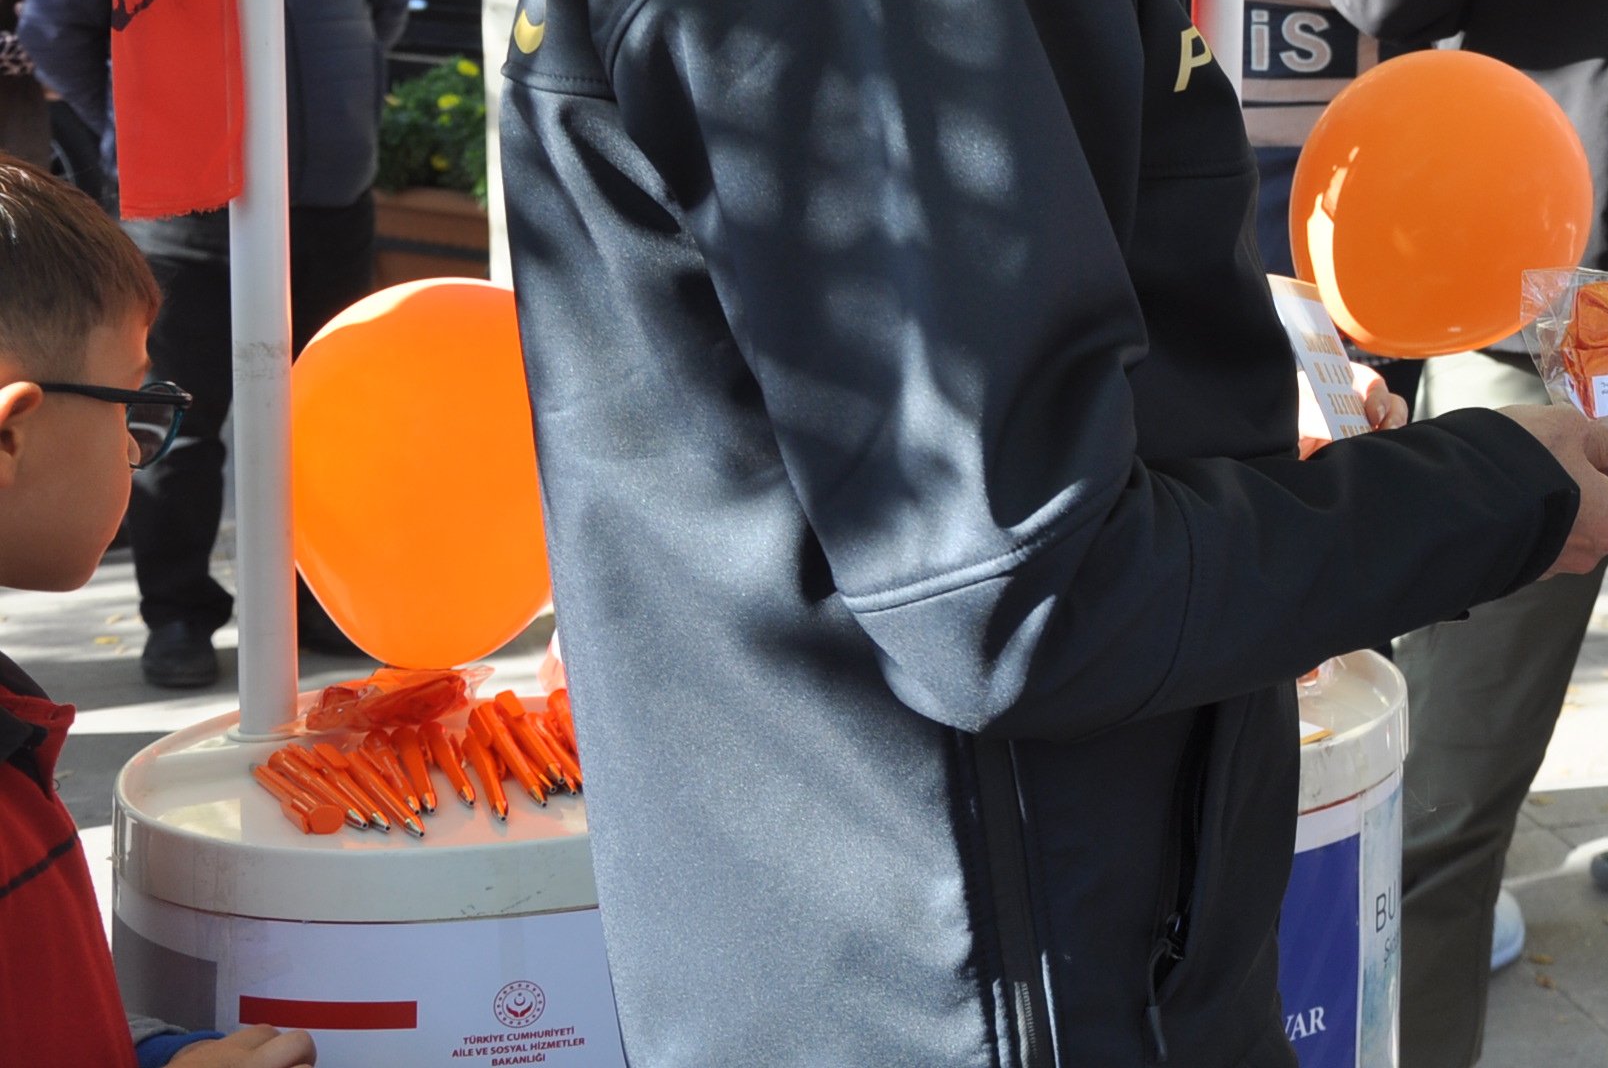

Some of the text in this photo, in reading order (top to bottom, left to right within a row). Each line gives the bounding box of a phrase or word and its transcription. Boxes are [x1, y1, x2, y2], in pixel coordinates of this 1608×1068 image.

[463, 1026, 575, 1045] TÜRKİYE CUMHURİYETİ
[452, 1036, 586, 1058] AİLE VE SOSYAL HİZMETLER
[491, 1053, 546, 1067] BAKANLIĞI
